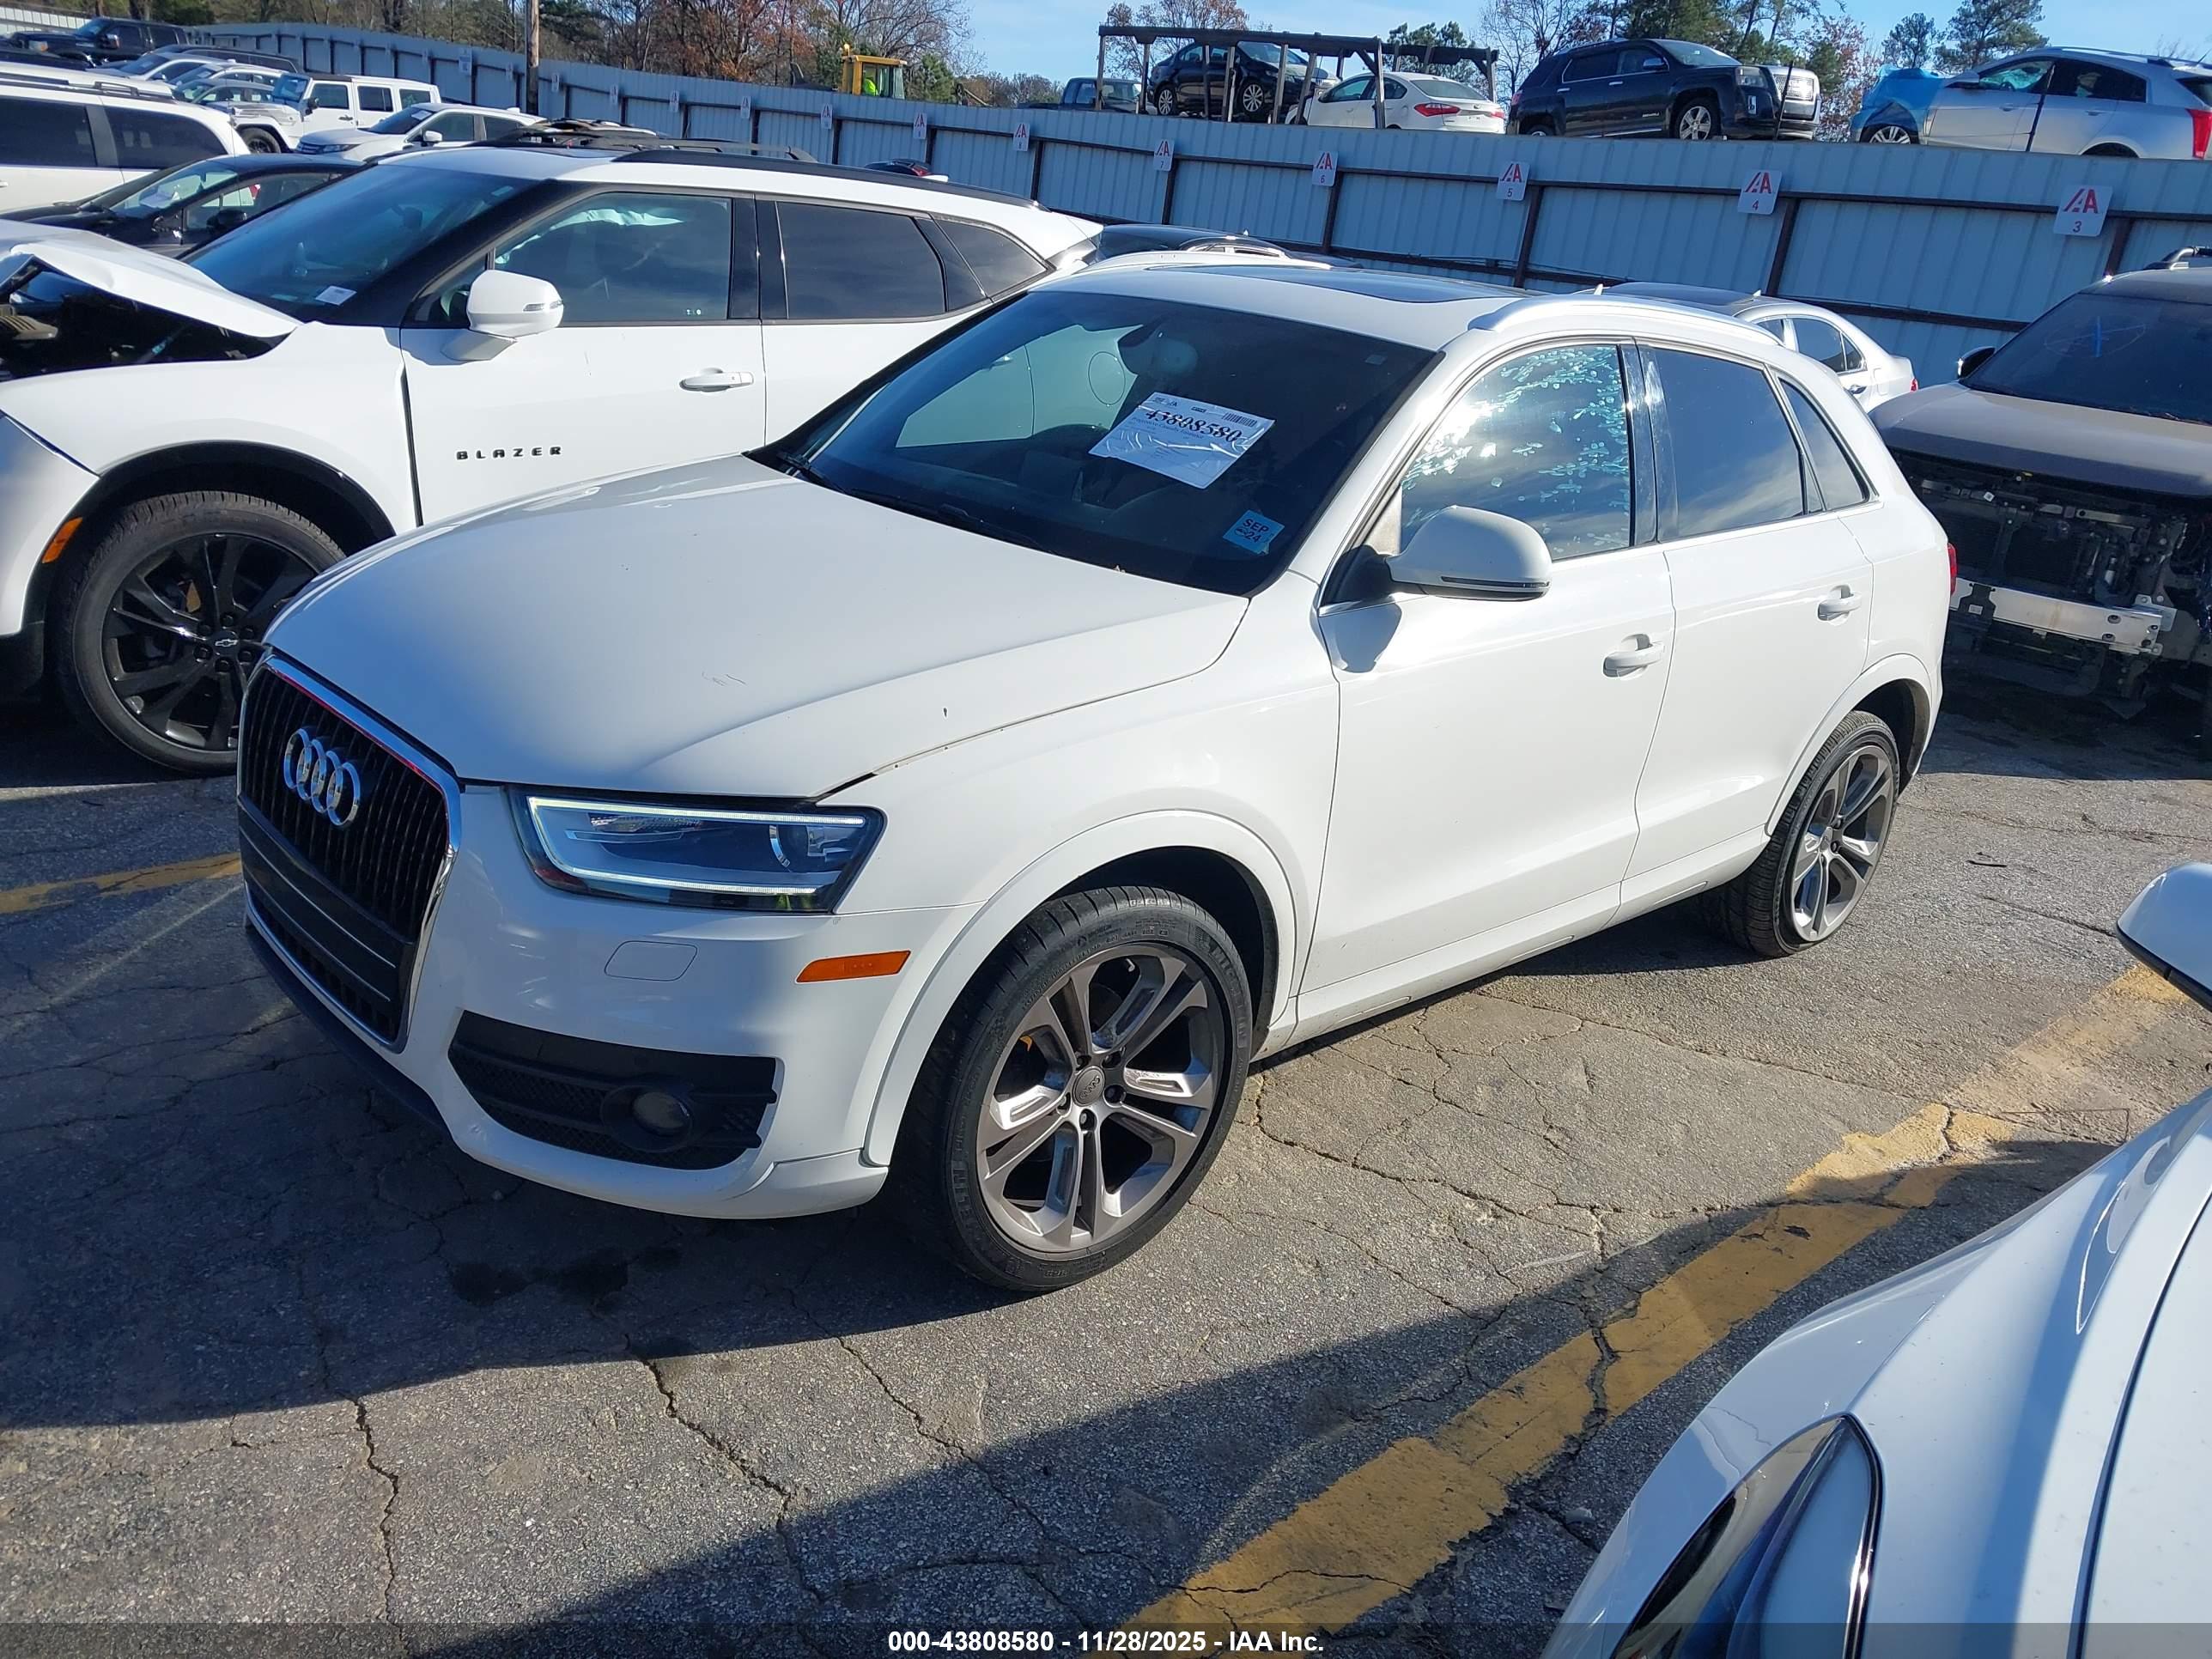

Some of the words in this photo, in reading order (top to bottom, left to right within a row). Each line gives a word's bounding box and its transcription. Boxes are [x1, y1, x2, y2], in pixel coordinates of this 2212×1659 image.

[1321, 174, 1325, 184] 6
[1507, 187, 1513, 198] 5
[1753, 200, 1759, 210] 4
[2073, 221, 2082, 233] 3
[456, 446, 561, 460] BLAZER
[1243, 518, 1269, 533] SEP
